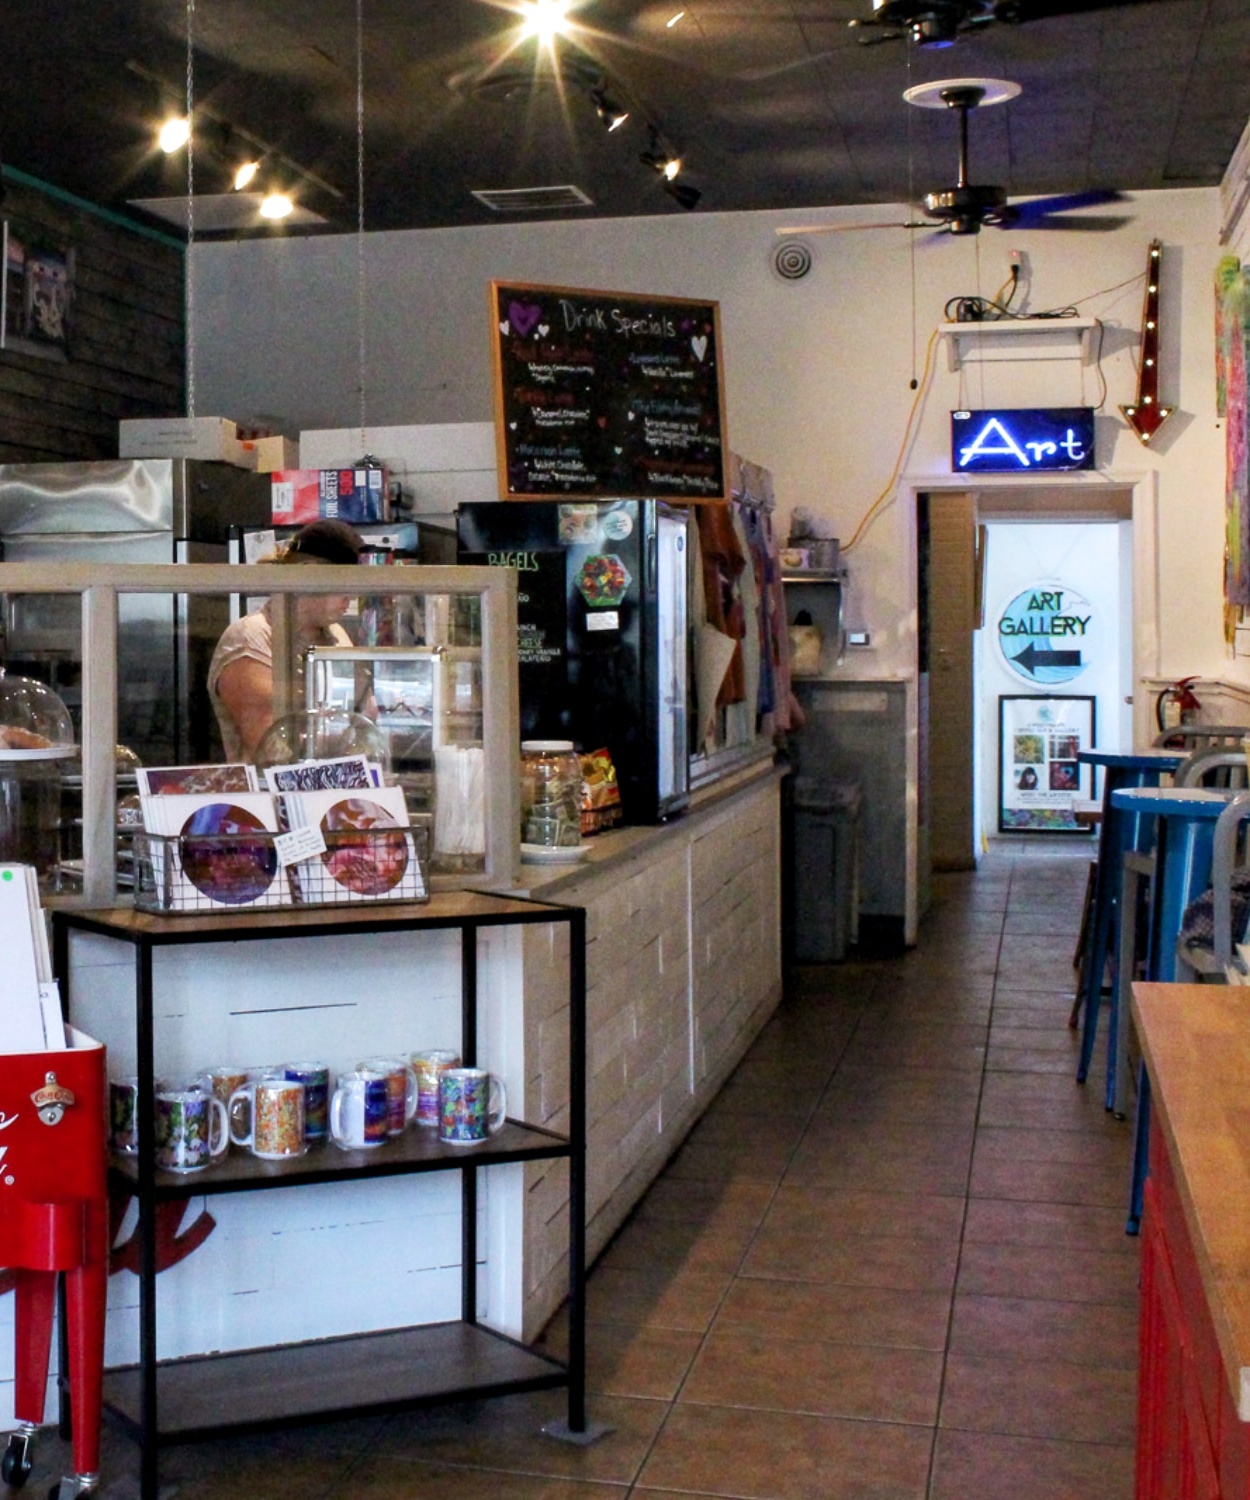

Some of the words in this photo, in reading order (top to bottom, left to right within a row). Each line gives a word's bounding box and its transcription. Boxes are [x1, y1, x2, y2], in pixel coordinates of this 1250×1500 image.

[558, 298, 608, 332] Drink
[611, 307, 676, 338] Specials
[959, 417, 1086, 467] Art
[326, 470, 338, 501] SHEETS
[326, 501, 338, 518] FOIL
[488, 551, 540, 572] BAGELS
[1027, 591, 1064, 611] ART
[998, 615, 1092, 636] GALLERY
